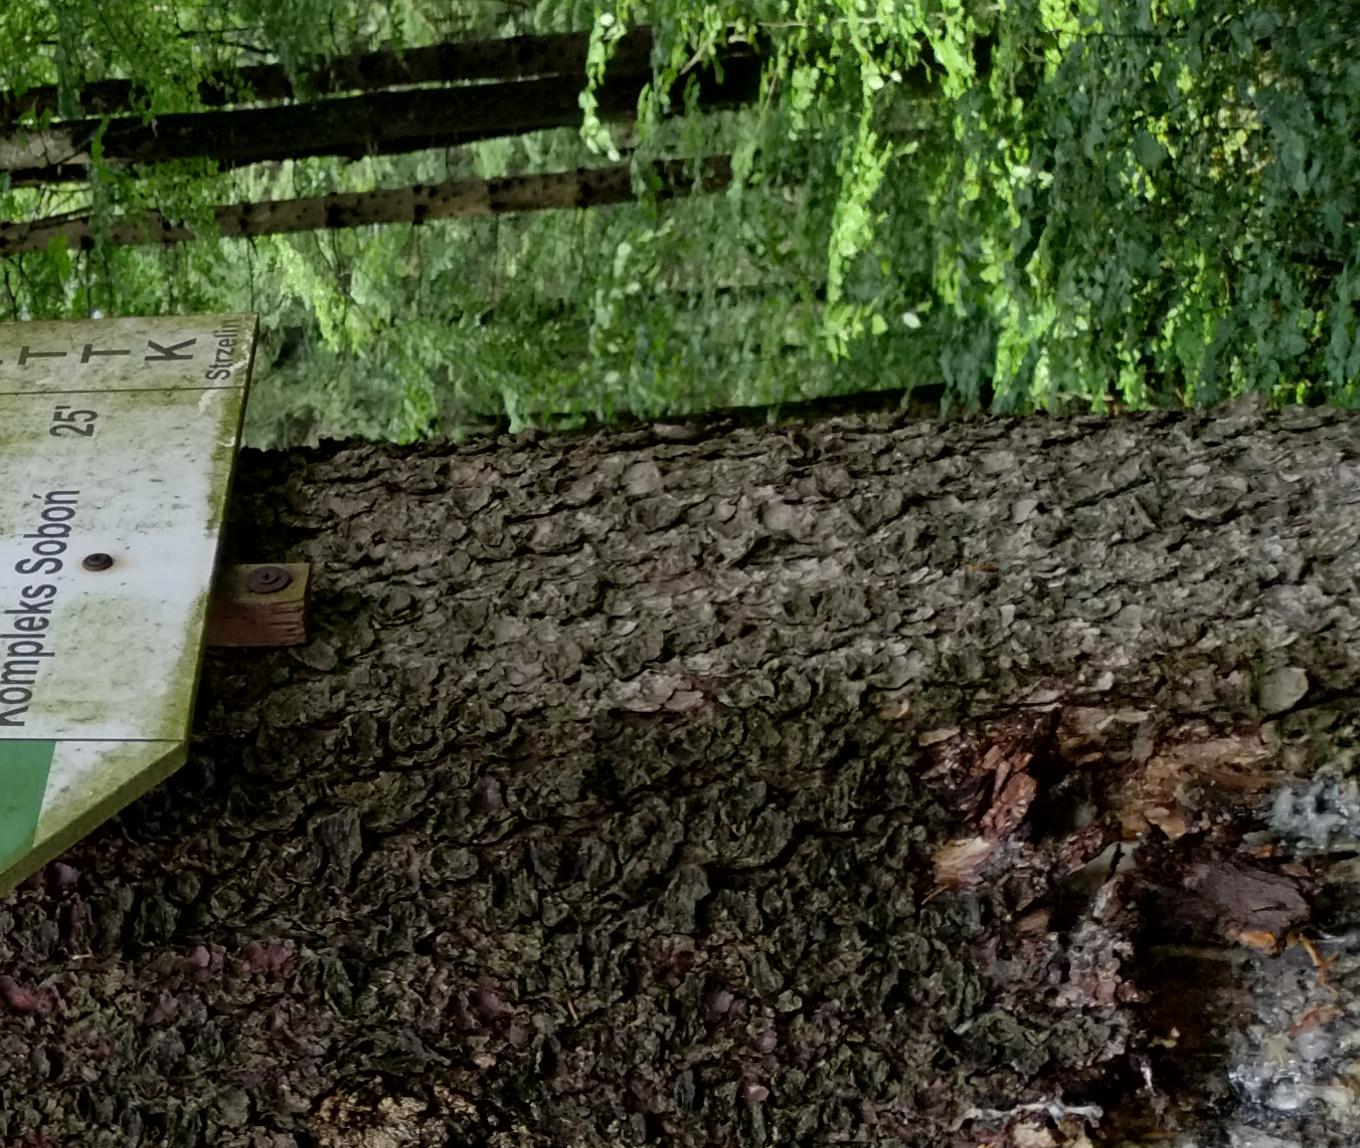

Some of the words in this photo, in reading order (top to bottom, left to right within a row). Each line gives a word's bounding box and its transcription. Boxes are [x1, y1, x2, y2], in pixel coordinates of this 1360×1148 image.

[205, 318, 240, 380] Strzelin
[49, 404, 98, 437] 25'
[19, 490, 80, 574] Soboń
